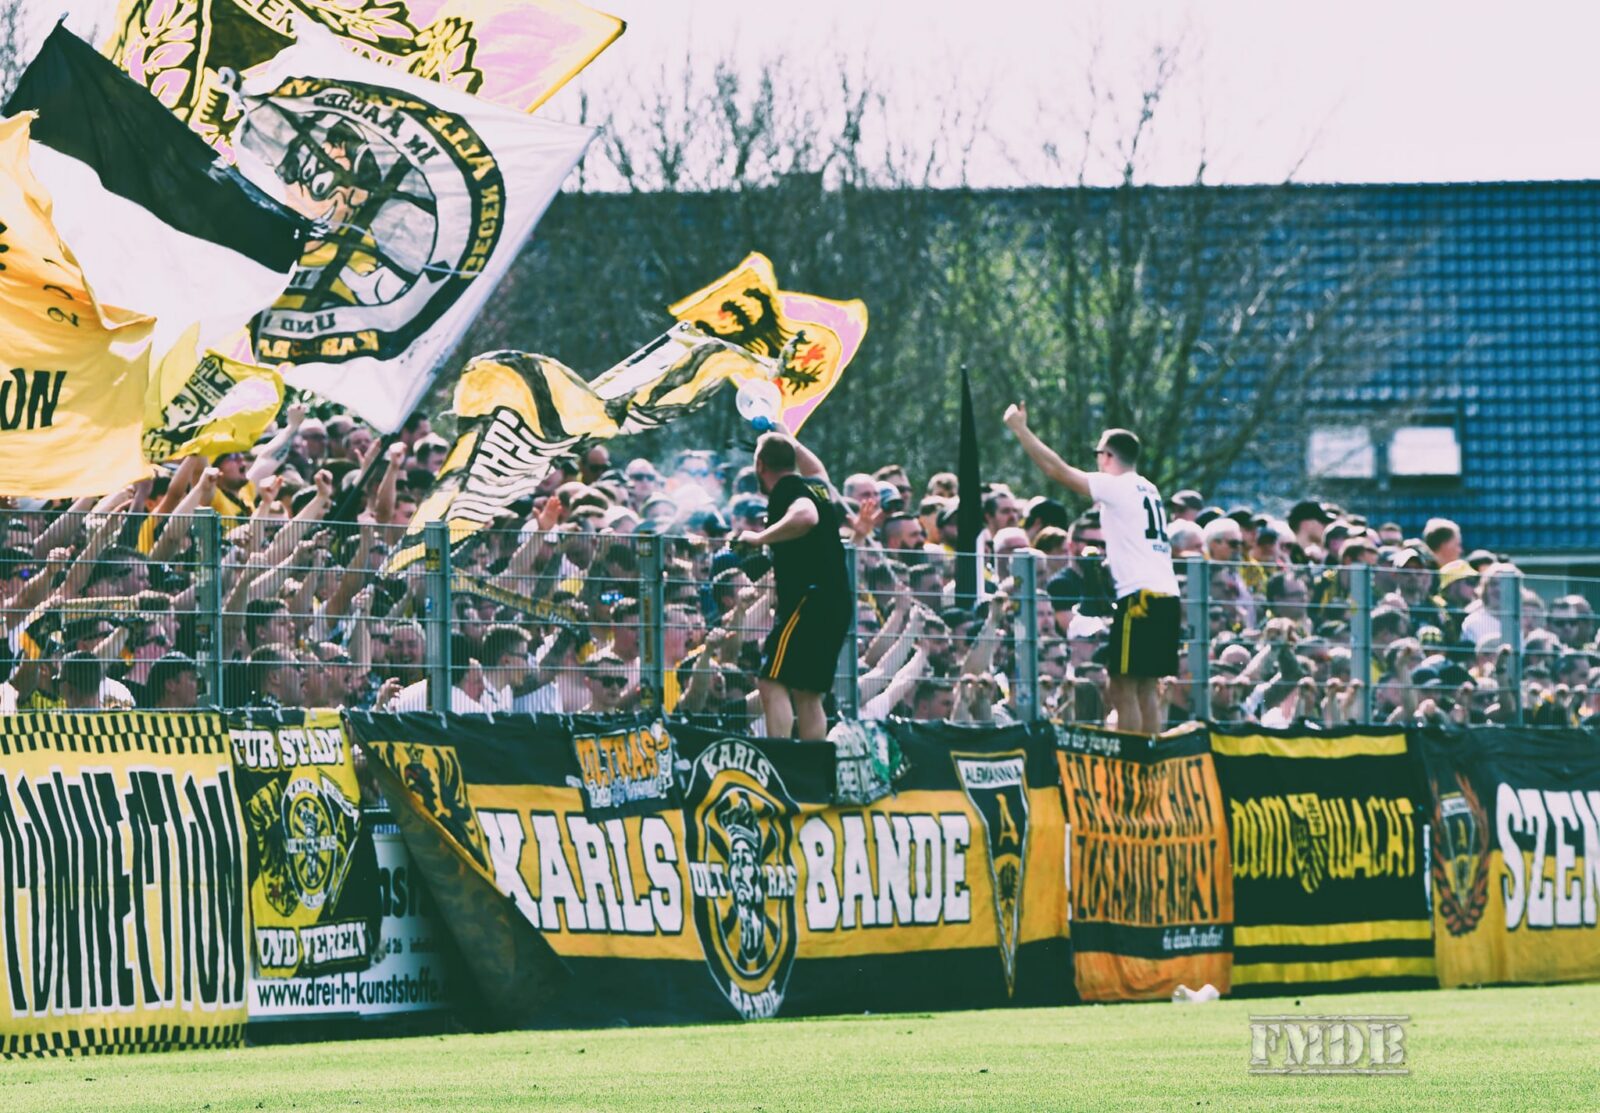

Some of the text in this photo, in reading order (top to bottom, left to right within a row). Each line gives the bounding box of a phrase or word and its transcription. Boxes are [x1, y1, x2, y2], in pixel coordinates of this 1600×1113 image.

[278, 728, 345, 767] STADT
[701, 742, 770, 789] KARLS
[995, 793, 1019, 846] A
[476, 808, 971, 934] KARLS BANDE
[257, 928, 298, 966] UND
[300, 921, 367, 965] VEREIN
